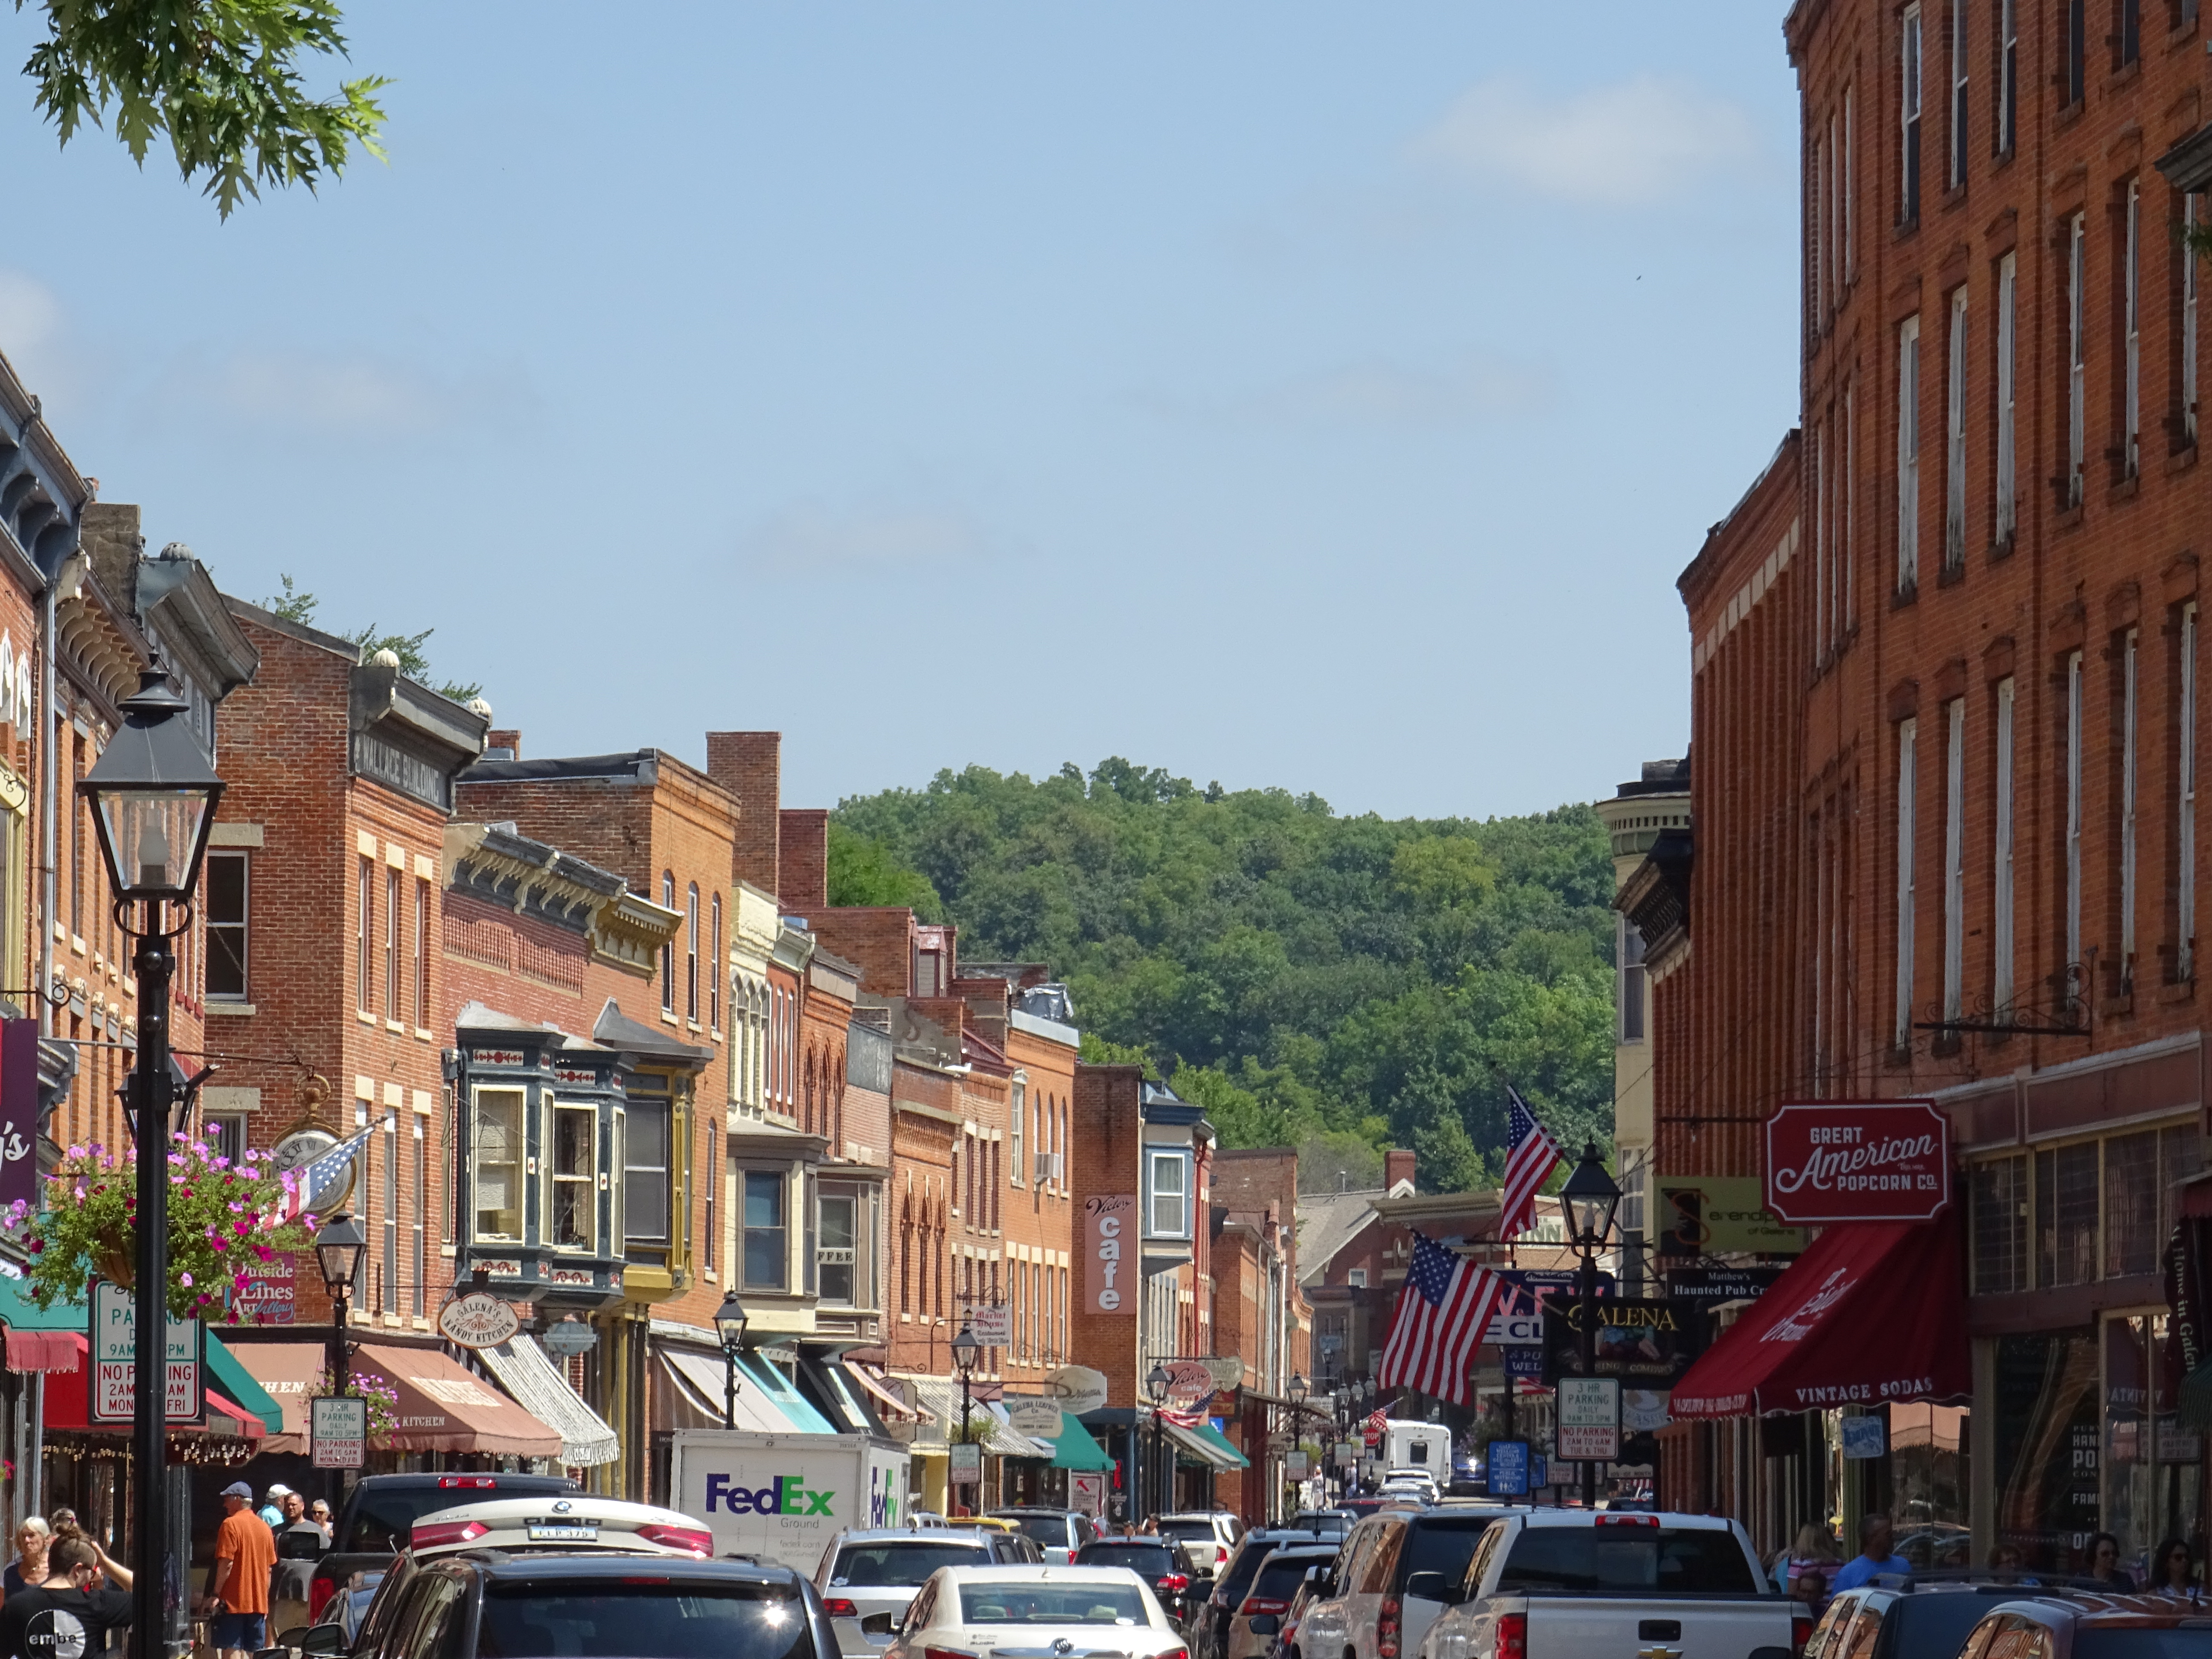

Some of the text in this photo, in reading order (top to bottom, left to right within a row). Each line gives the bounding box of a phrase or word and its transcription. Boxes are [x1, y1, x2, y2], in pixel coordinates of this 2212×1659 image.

[363, 733, 400, 784] WALLACE
[403, 753, 439, 803] BUILDING
[1810, 1127, 1863, 1144] GREAT
[1775, 1134, 1938, 1193] American
[1837, 1175, 1911, 1191] POPCORN
[1086, 1196, 1132, 1217] Victory
[1521, 1225, 1562, 1243] INN
[1098, 1216, 1121, 1310] cafe
[2172, 1247, 2185, 1295] Home
[239, 1281, 294, 1300] Lines
[1675, 1284, 1721, 1295] Haunted
[1725, 1285, 1746, 1295] Pub
[457, 1303, 501, 1318] GALENA'S
[976, 1310, 1006, 1320] Market
[2177, 1299, 2189, 1319] in
[1568, 1304, 1679, 1332] GALENA
[476, 1320, 513, 1342] KITCHEN
[168, 1344, 185, 1356] PM
[103, 1366, 192, 1380] NO PING
[1512, 1362, 1542, 1371] WEL
[1166, 1367, 1209, 1385] Victory
[109, 1384, 135, 1396] 2AM
[1578, 1383, 1600, 1393] 3 HR
[1796, 1377, 1933, 1403] VINTAGE SODAS
[1568, 1394, 1610, 1405] PARKING
[330, 1403, 334, 1412] 3
[1578, 1406, 1598, 1414] DAILY
[322, 1413, 356, 1421] PARKING
[402, 1416, 445, 1427] KITCHEN
[1567, 1415, 1582, 1423] 9AM
[1363, 1432, 1379, 1440] STOP
[1563, 1427, 1614, 1437] NO PARKING
[317, 1440, 361, 1449] NO PARKING
[1567, 1438, 1582, 1446] 2AM
[1584, 1438, 1593, 1446] TO
[2073, 1434, 2099, 1447] HAN
[2073, 1449, 2099, 1468] PO
[706, 1473, 835, 1516] FedEx
[2073, 1493, 2099, 1505] FAM
[780, 1517, 819, 1528] Ground
[29, 1632, 76, 1645] embe
